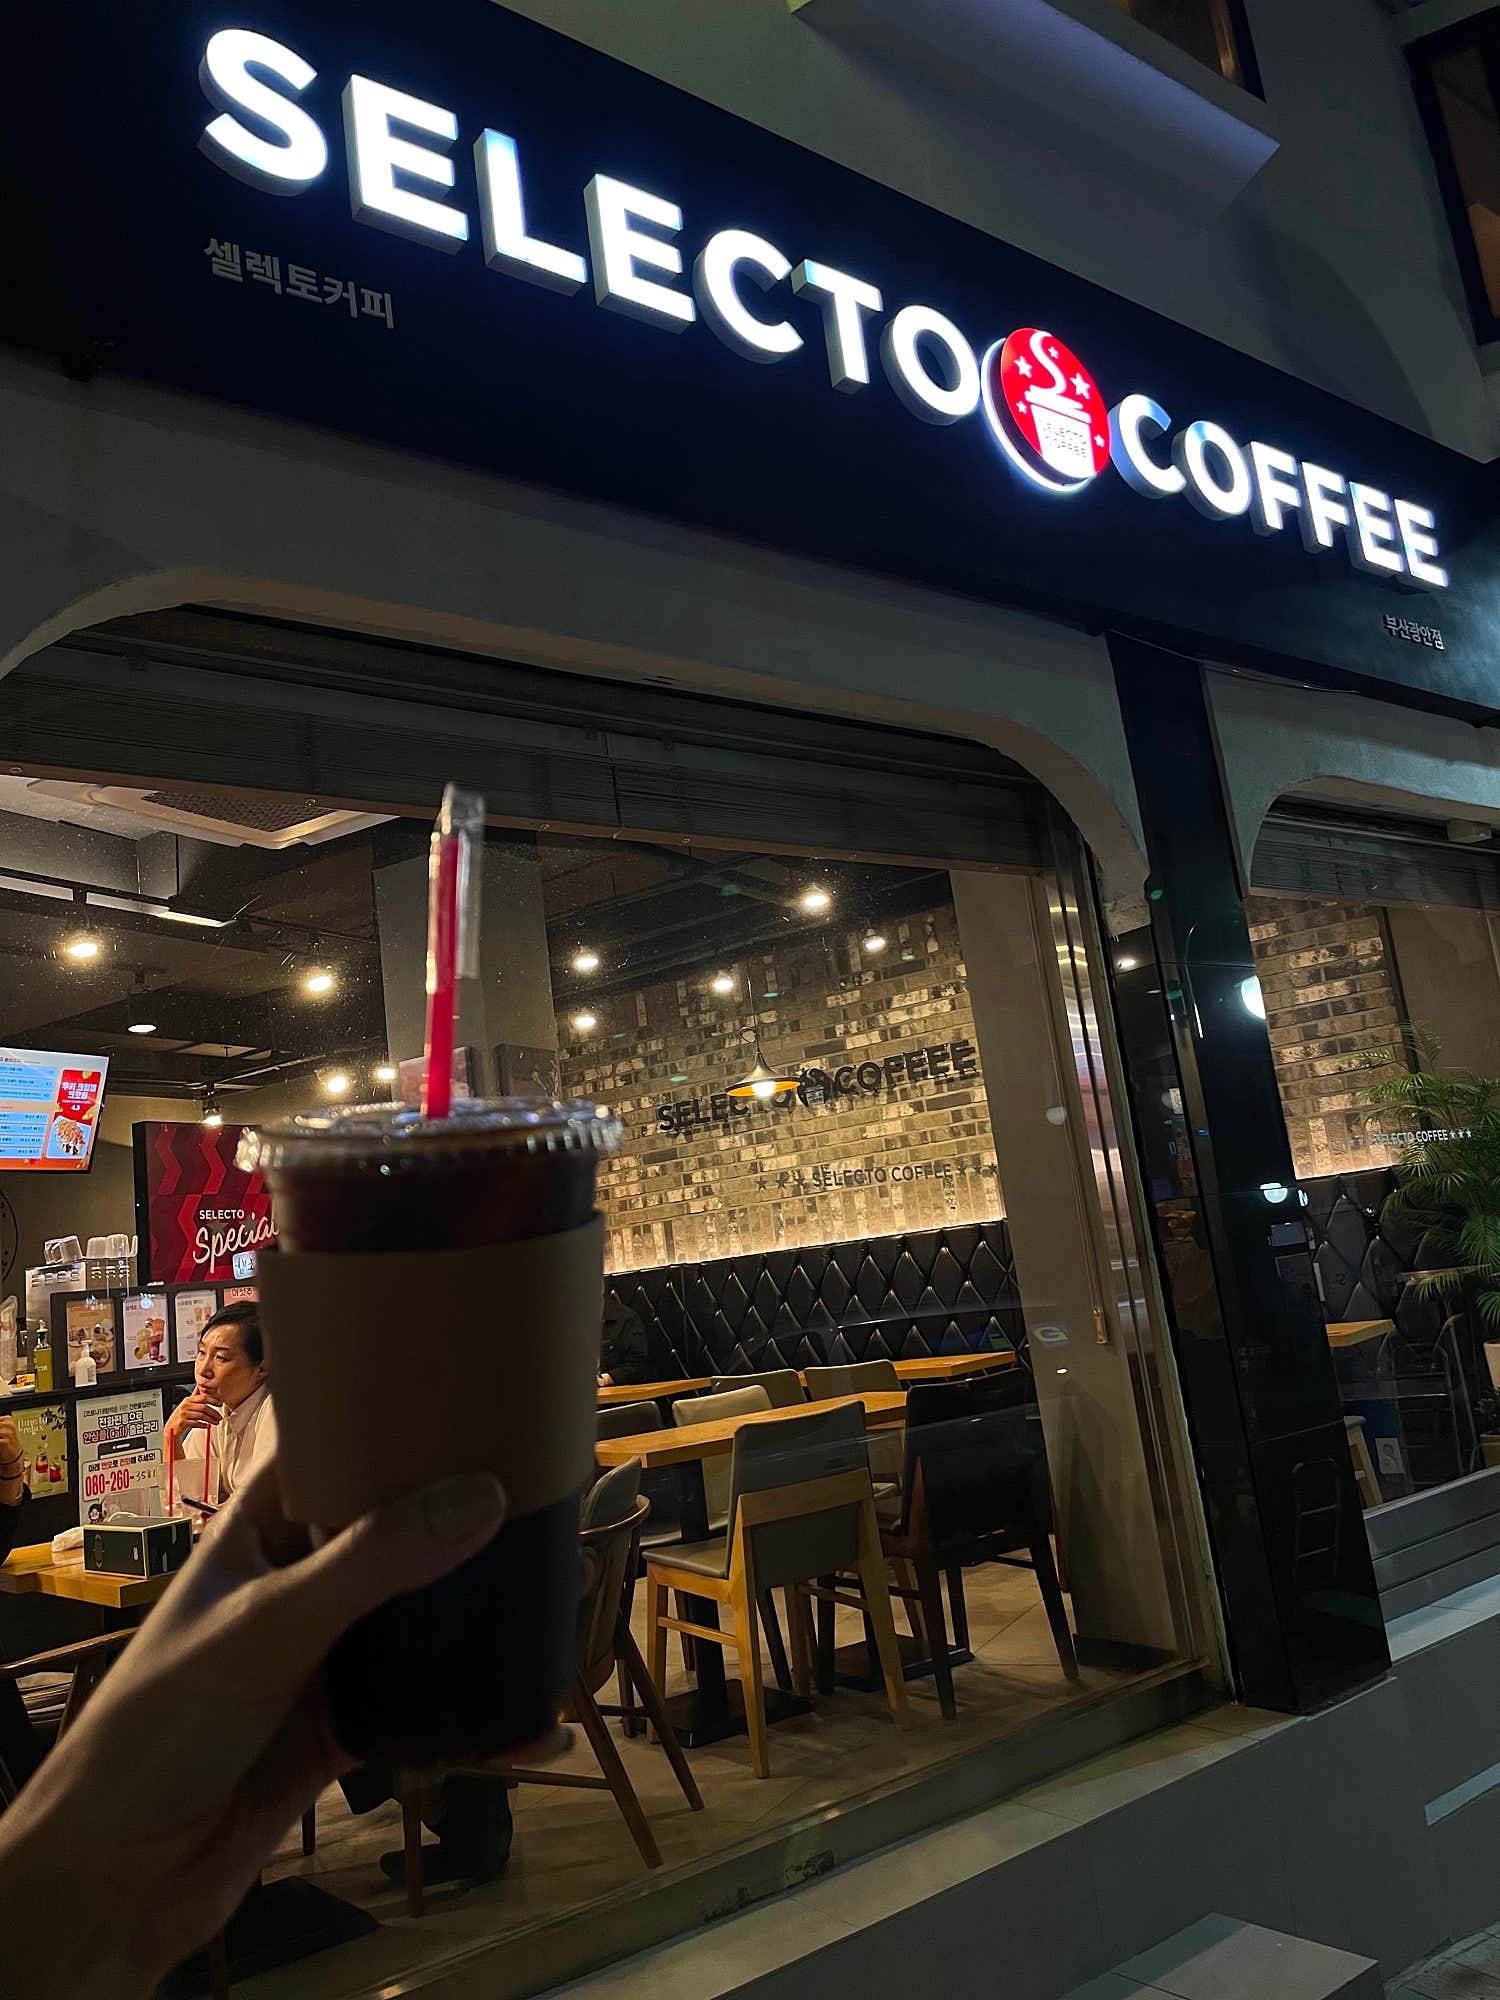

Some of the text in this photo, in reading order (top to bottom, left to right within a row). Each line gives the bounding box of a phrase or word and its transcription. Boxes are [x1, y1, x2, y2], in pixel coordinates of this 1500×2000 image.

[203, 237, 395, 330] 셀렉토커피
[199, 27, 1450, 593] SELECTO COFFEE
[1384, 613, 1446, 650] 부산광안점
[832, 1039, 977, 1096] COFFEE
[1416, 1129, 1449, 1142] COFFEE
[811, 1165, 888, 1188] SELECTO
[199, 1209, 245, 1220] SELECTO
